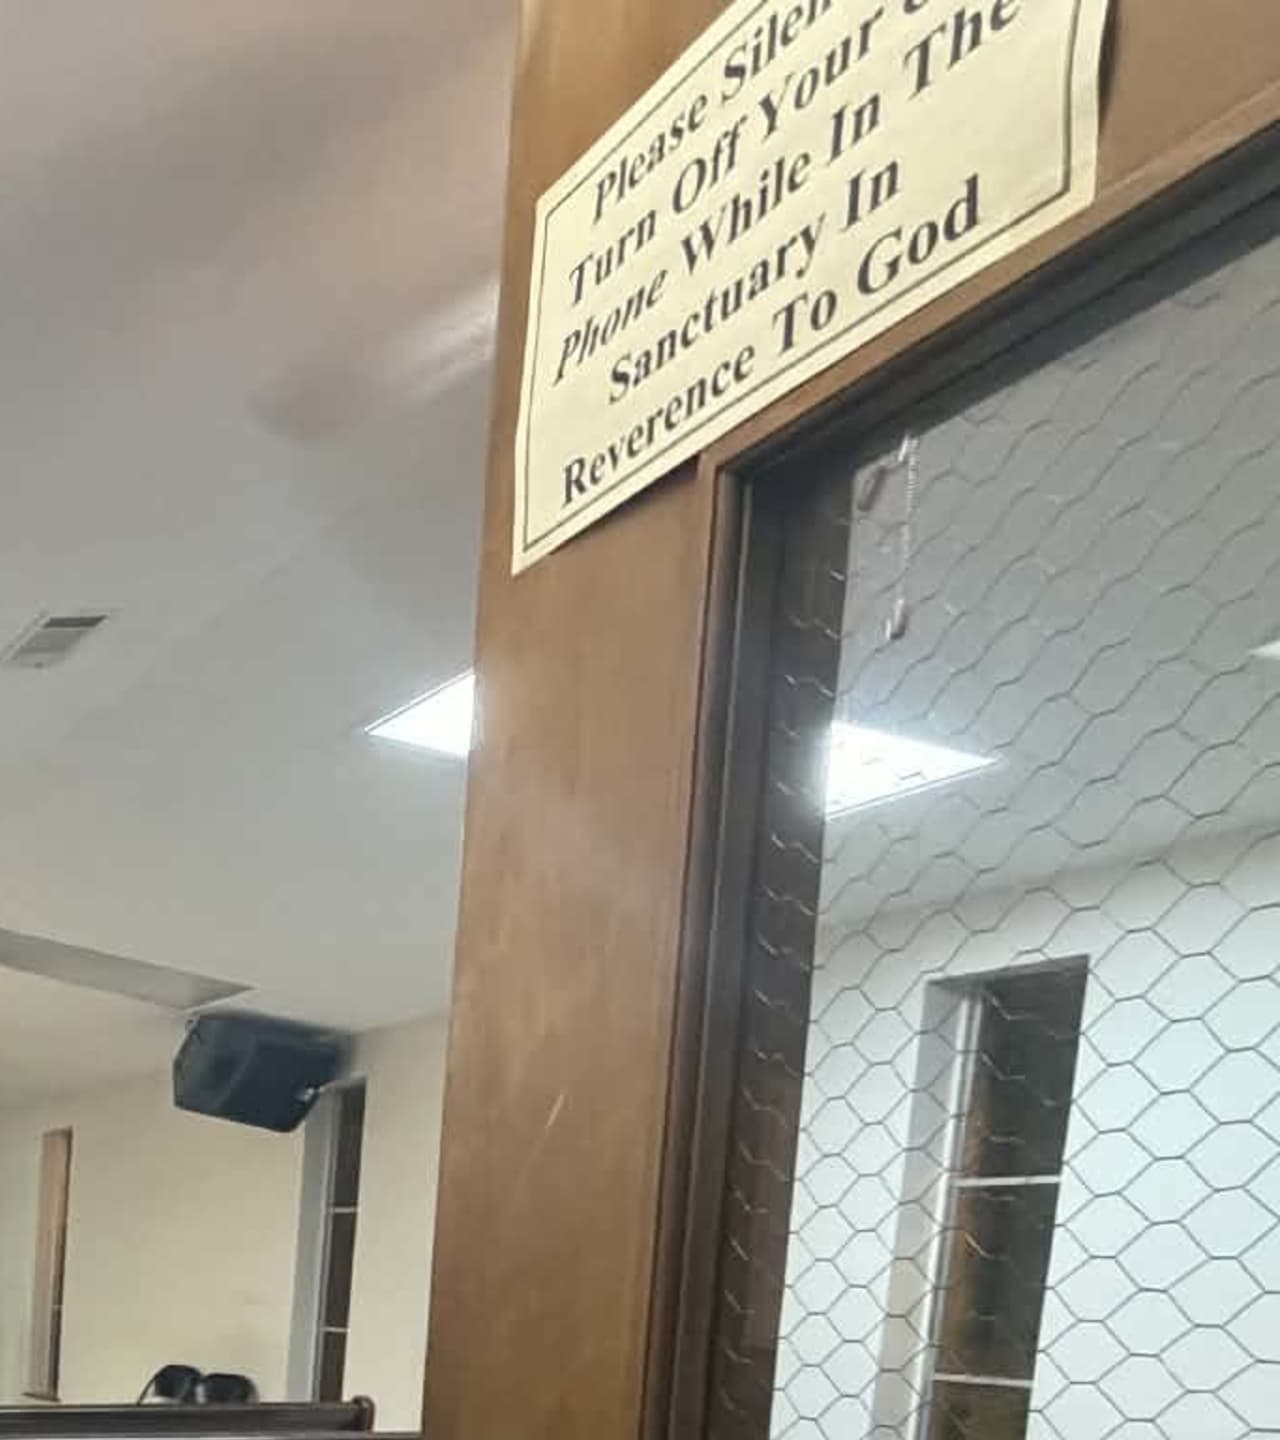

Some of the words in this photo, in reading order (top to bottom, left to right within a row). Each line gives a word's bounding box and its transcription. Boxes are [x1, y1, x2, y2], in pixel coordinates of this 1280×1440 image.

[552, 267, 667, 387] Phone
[682, 151, 813, 275] While
[828, 93, 882, 166] In
[903, 0, 1021, 102] The
[567, 217, 658, 310] Turn
[671, 117, 748, 219] Off
[757, 6, 886, 139] Your
[592, 90, 709, 226] Please
[607, 214, 827, 405] Sanctuary
[844, 157, 902, 234] In
[561, 345, 756, 509] Reverence
[771, 292, 838, 358] To
[858, 172, 981, 298] God
